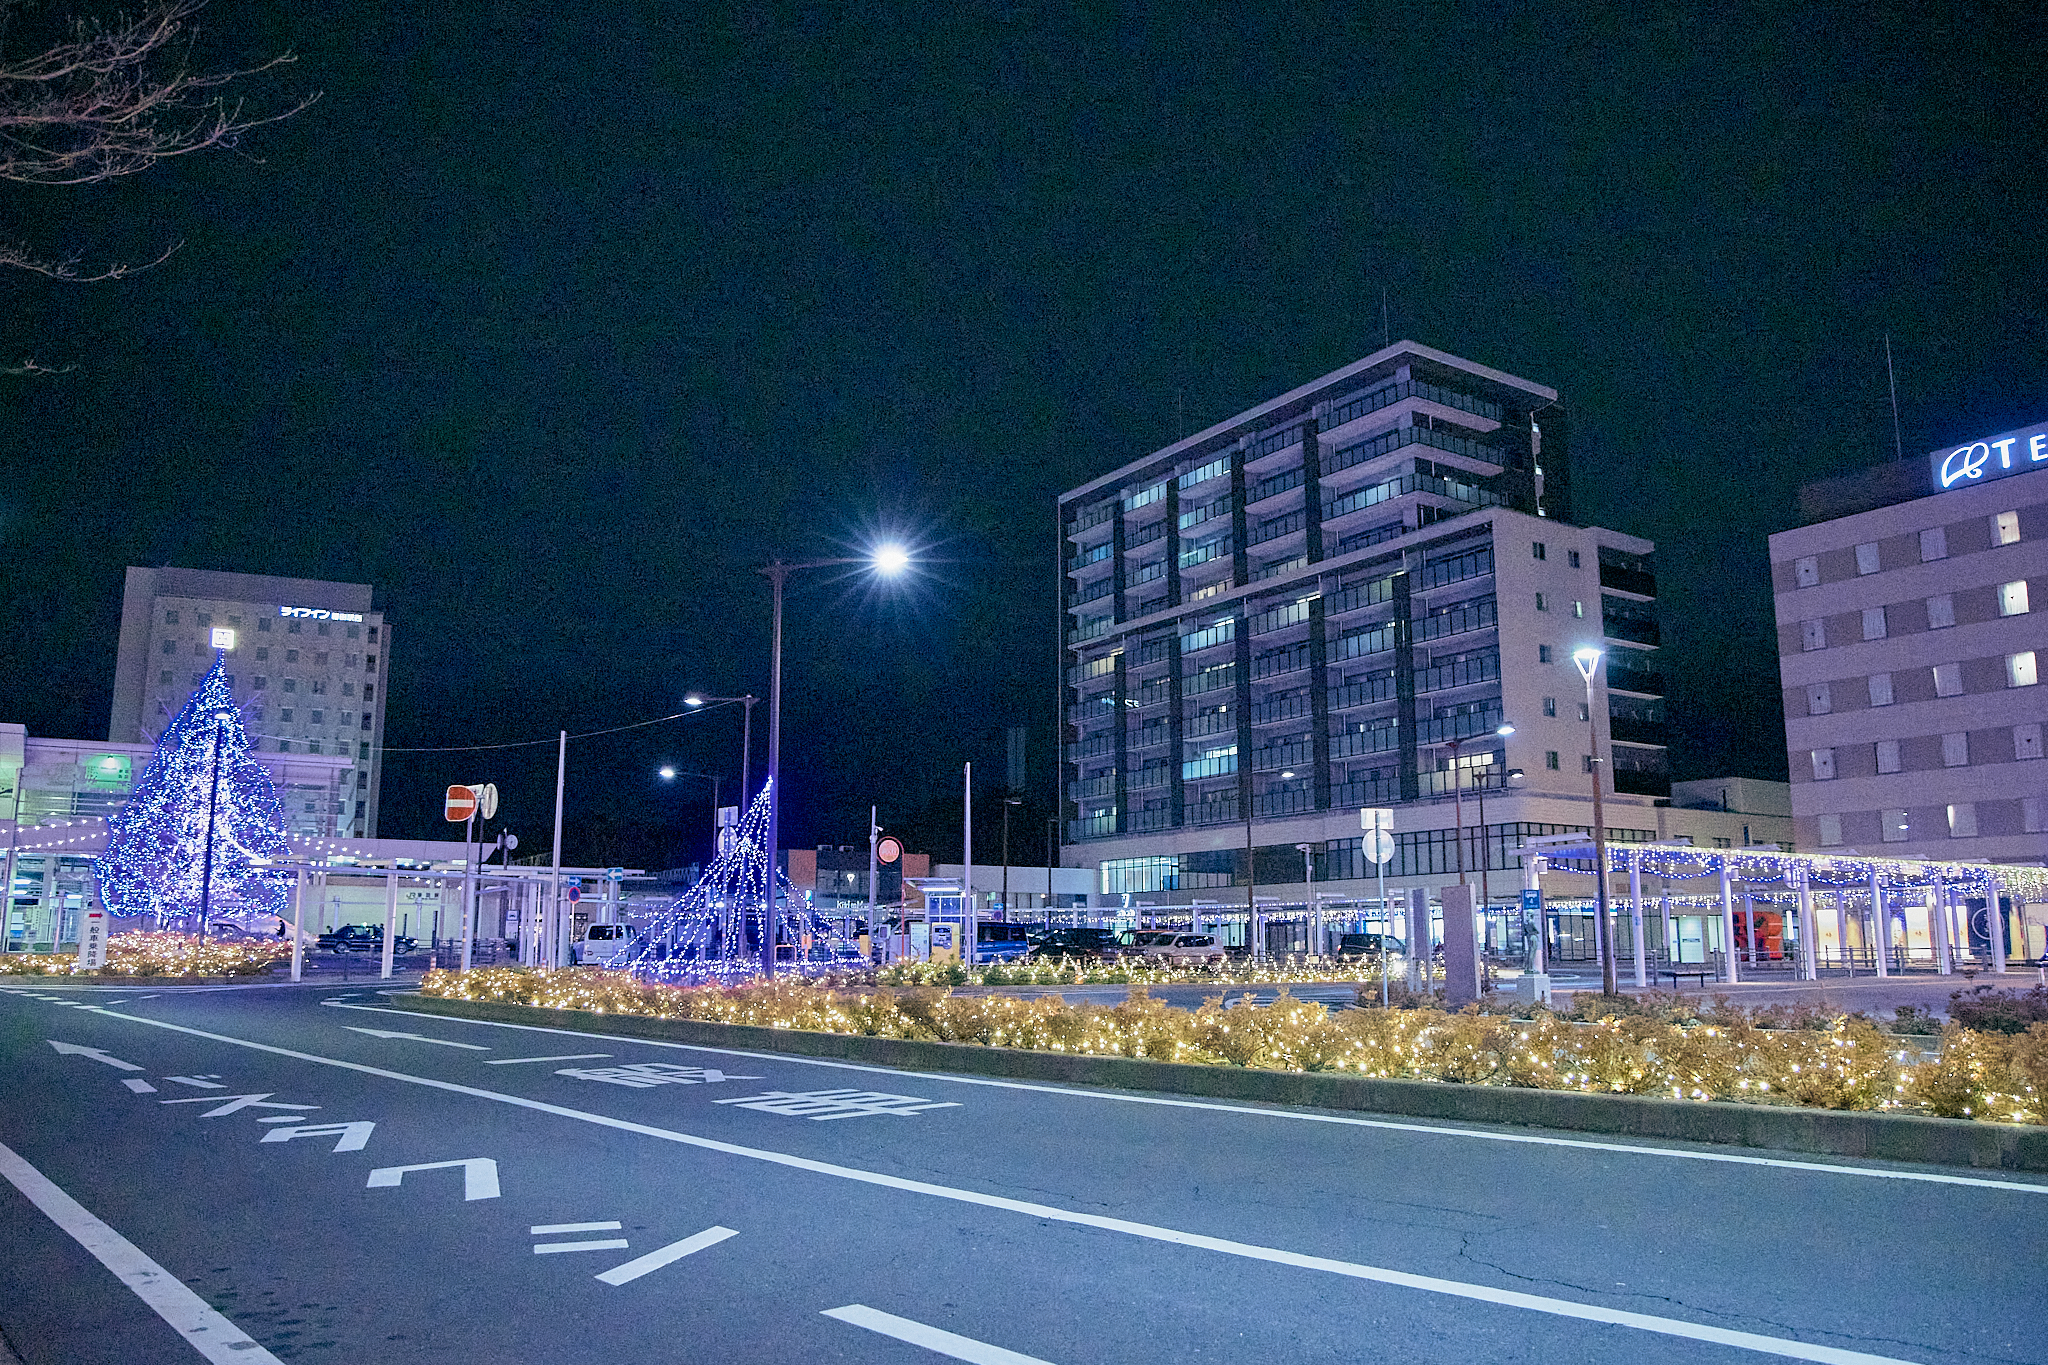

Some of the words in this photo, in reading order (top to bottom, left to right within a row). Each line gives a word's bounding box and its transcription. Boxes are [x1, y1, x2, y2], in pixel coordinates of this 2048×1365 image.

[280, 606, 331, 619] ライフイン
